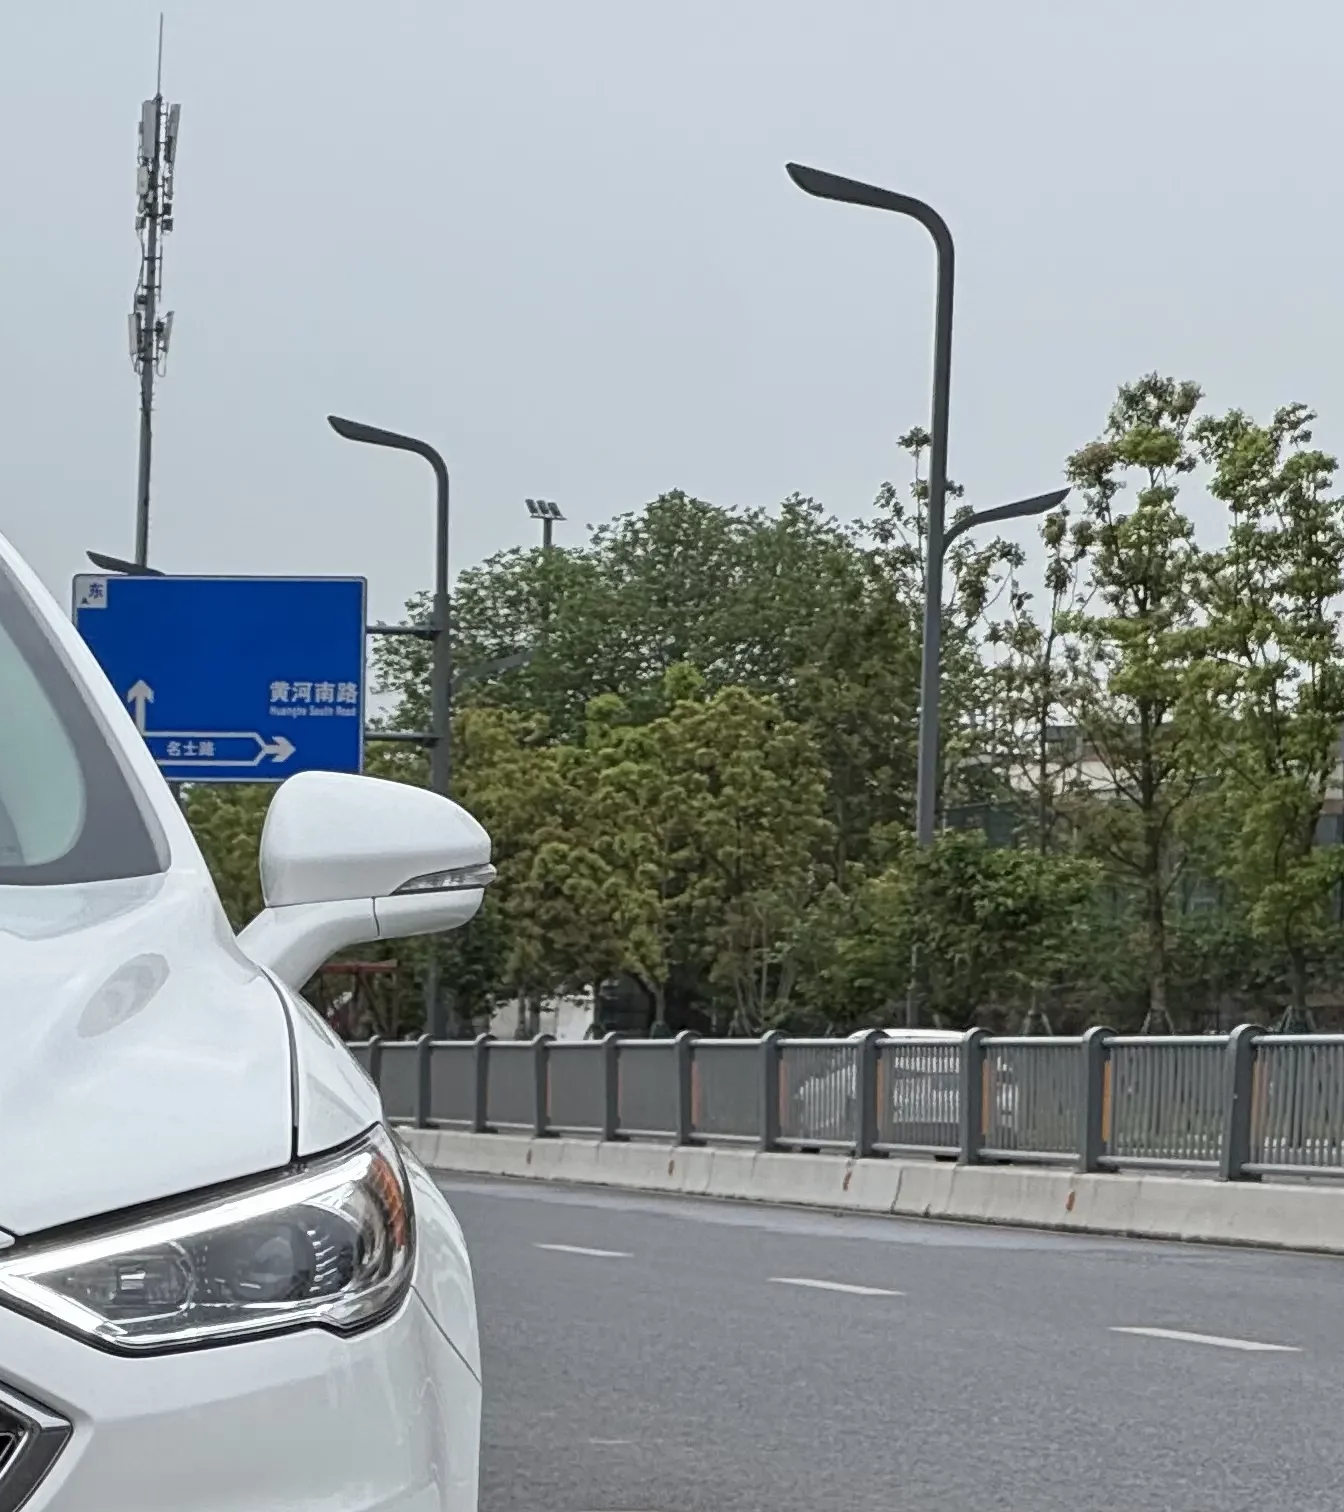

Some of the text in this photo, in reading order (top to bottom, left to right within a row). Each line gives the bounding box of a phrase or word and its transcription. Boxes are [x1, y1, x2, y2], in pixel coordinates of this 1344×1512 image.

[89, 583, 104, 599] 东
[270, 681, 358, 704] 黄河南路
[336, 705, 356, 717] Road
[166, 740, 214, 756] 名士路
